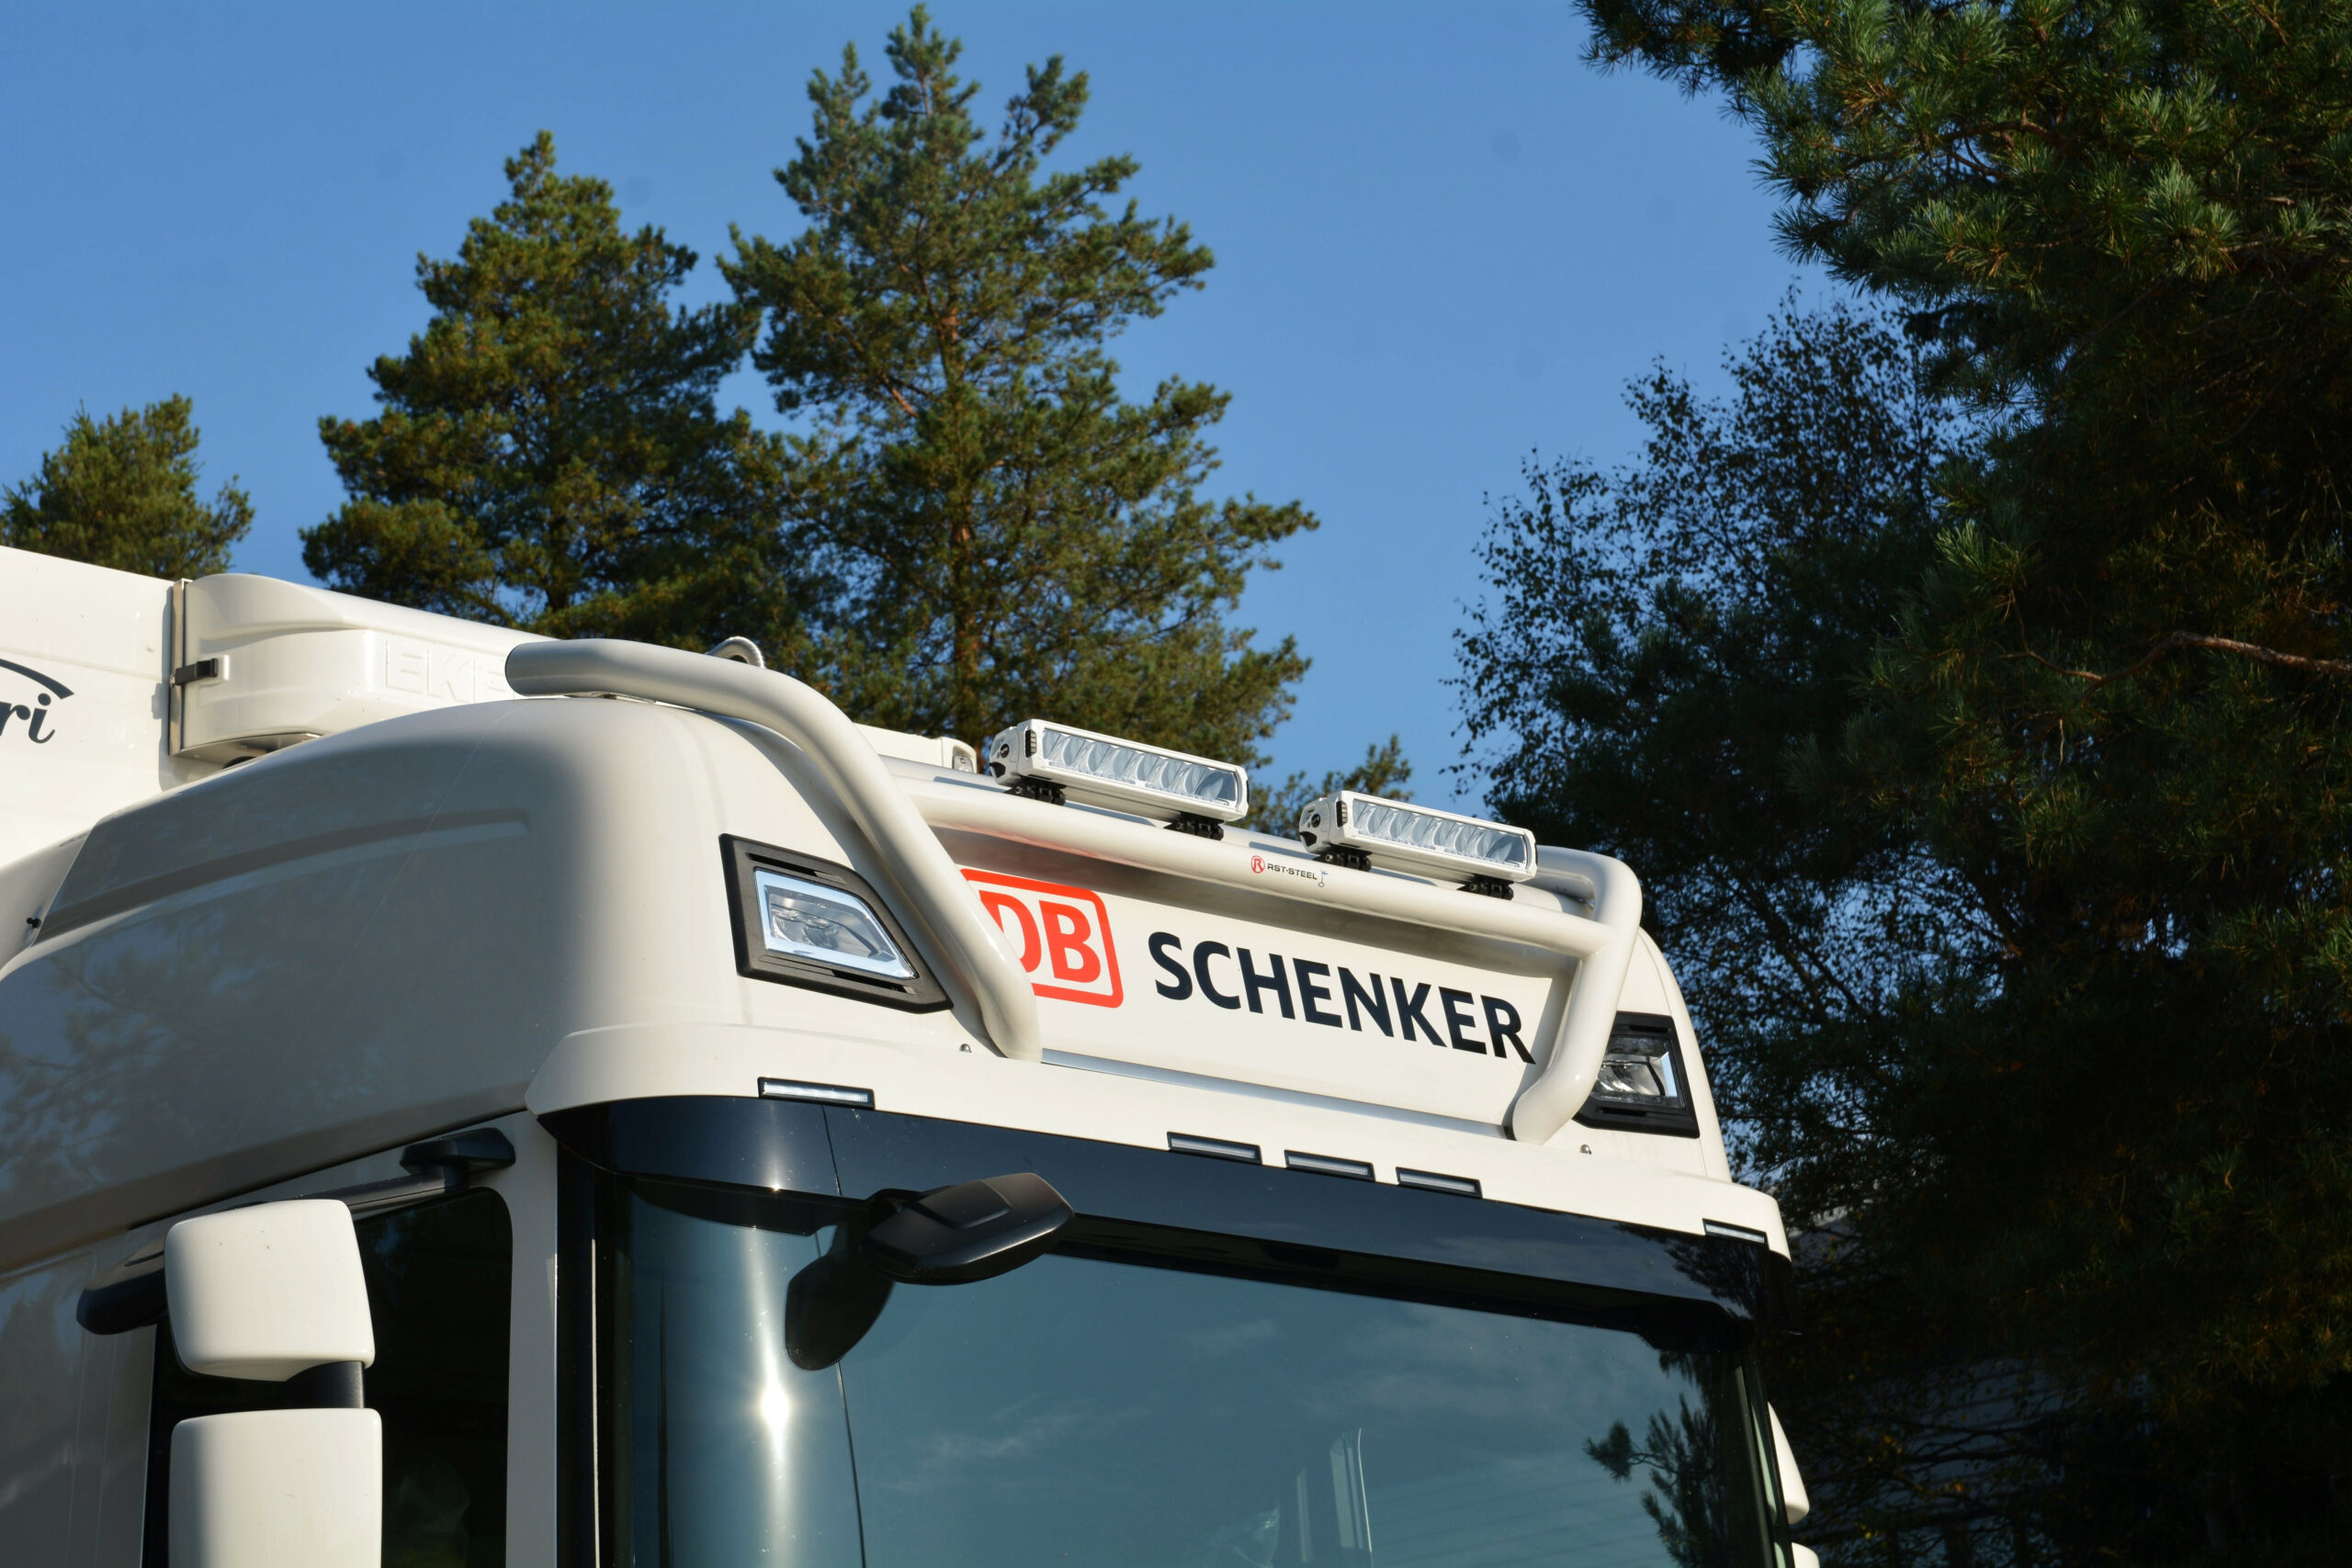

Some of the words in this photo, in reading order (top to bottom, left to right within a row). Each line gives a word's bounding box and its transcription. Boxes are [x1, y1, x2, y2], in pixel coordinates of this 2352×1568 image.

[1267, 863, 1317, 880] RST-STEEL
[978, 888, 1102, 984] DB
[1147, 931, 1537, 1065] SCHENKER
